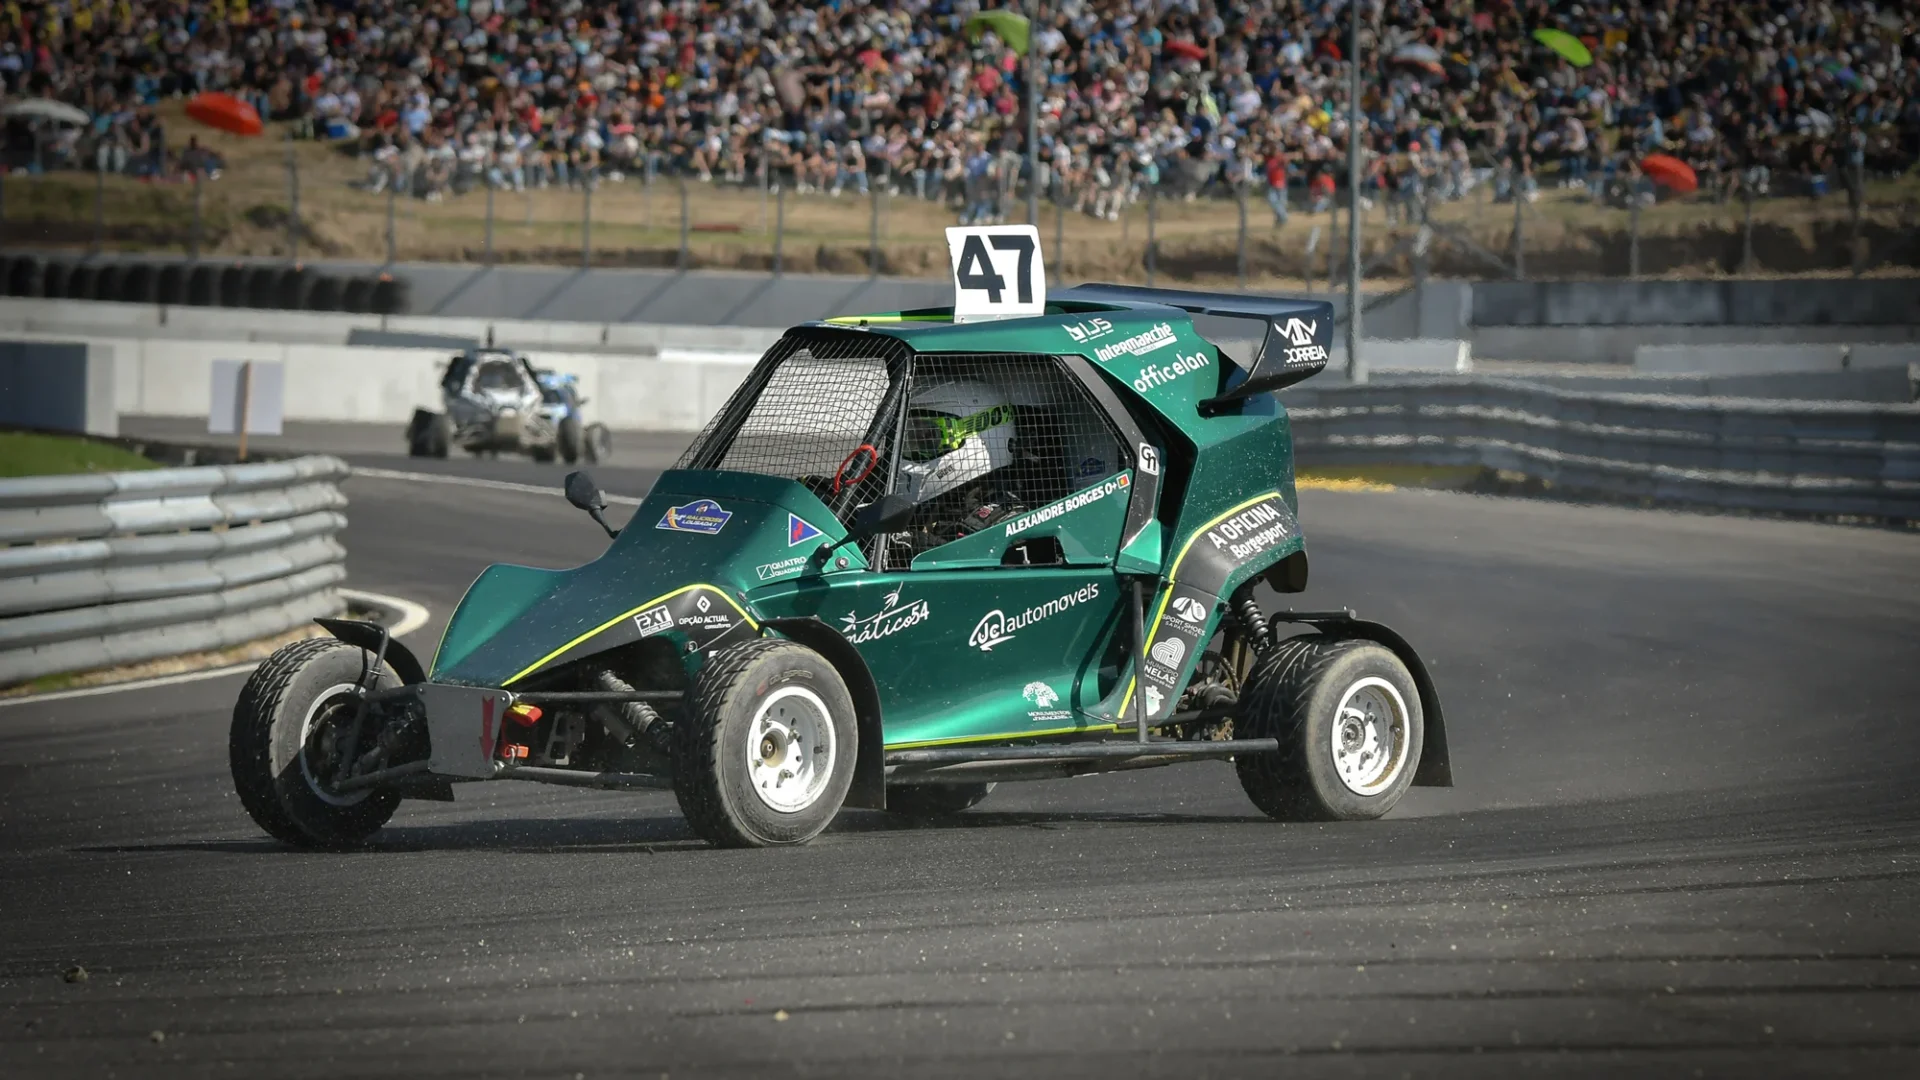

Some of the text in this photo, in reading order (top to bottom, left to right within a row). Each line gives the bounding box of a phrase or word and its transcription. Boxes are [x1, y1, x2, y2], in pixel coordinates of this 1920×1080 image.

[956, 234, 1036, 304] 47
[1134, 352, 1210, 393] officelan
[1005, 502, 1065, 537] ALEXANDRE
[1065, 486, 1105, 512] BORGES
[1208, 503, 1281, 549] A OFICINA
[1229, 522, 1288, 559] Borgesport
[771, 556, 808, 570] QUATRO
[679, 614, 729, 626] OPÇÃO ACTUAL
[1161, 613, 1206, 637] SPORT SHOES
[1165, 620, 1199, 638] SAPATARIA
[1144, 664, 1176, 685] NELAS
